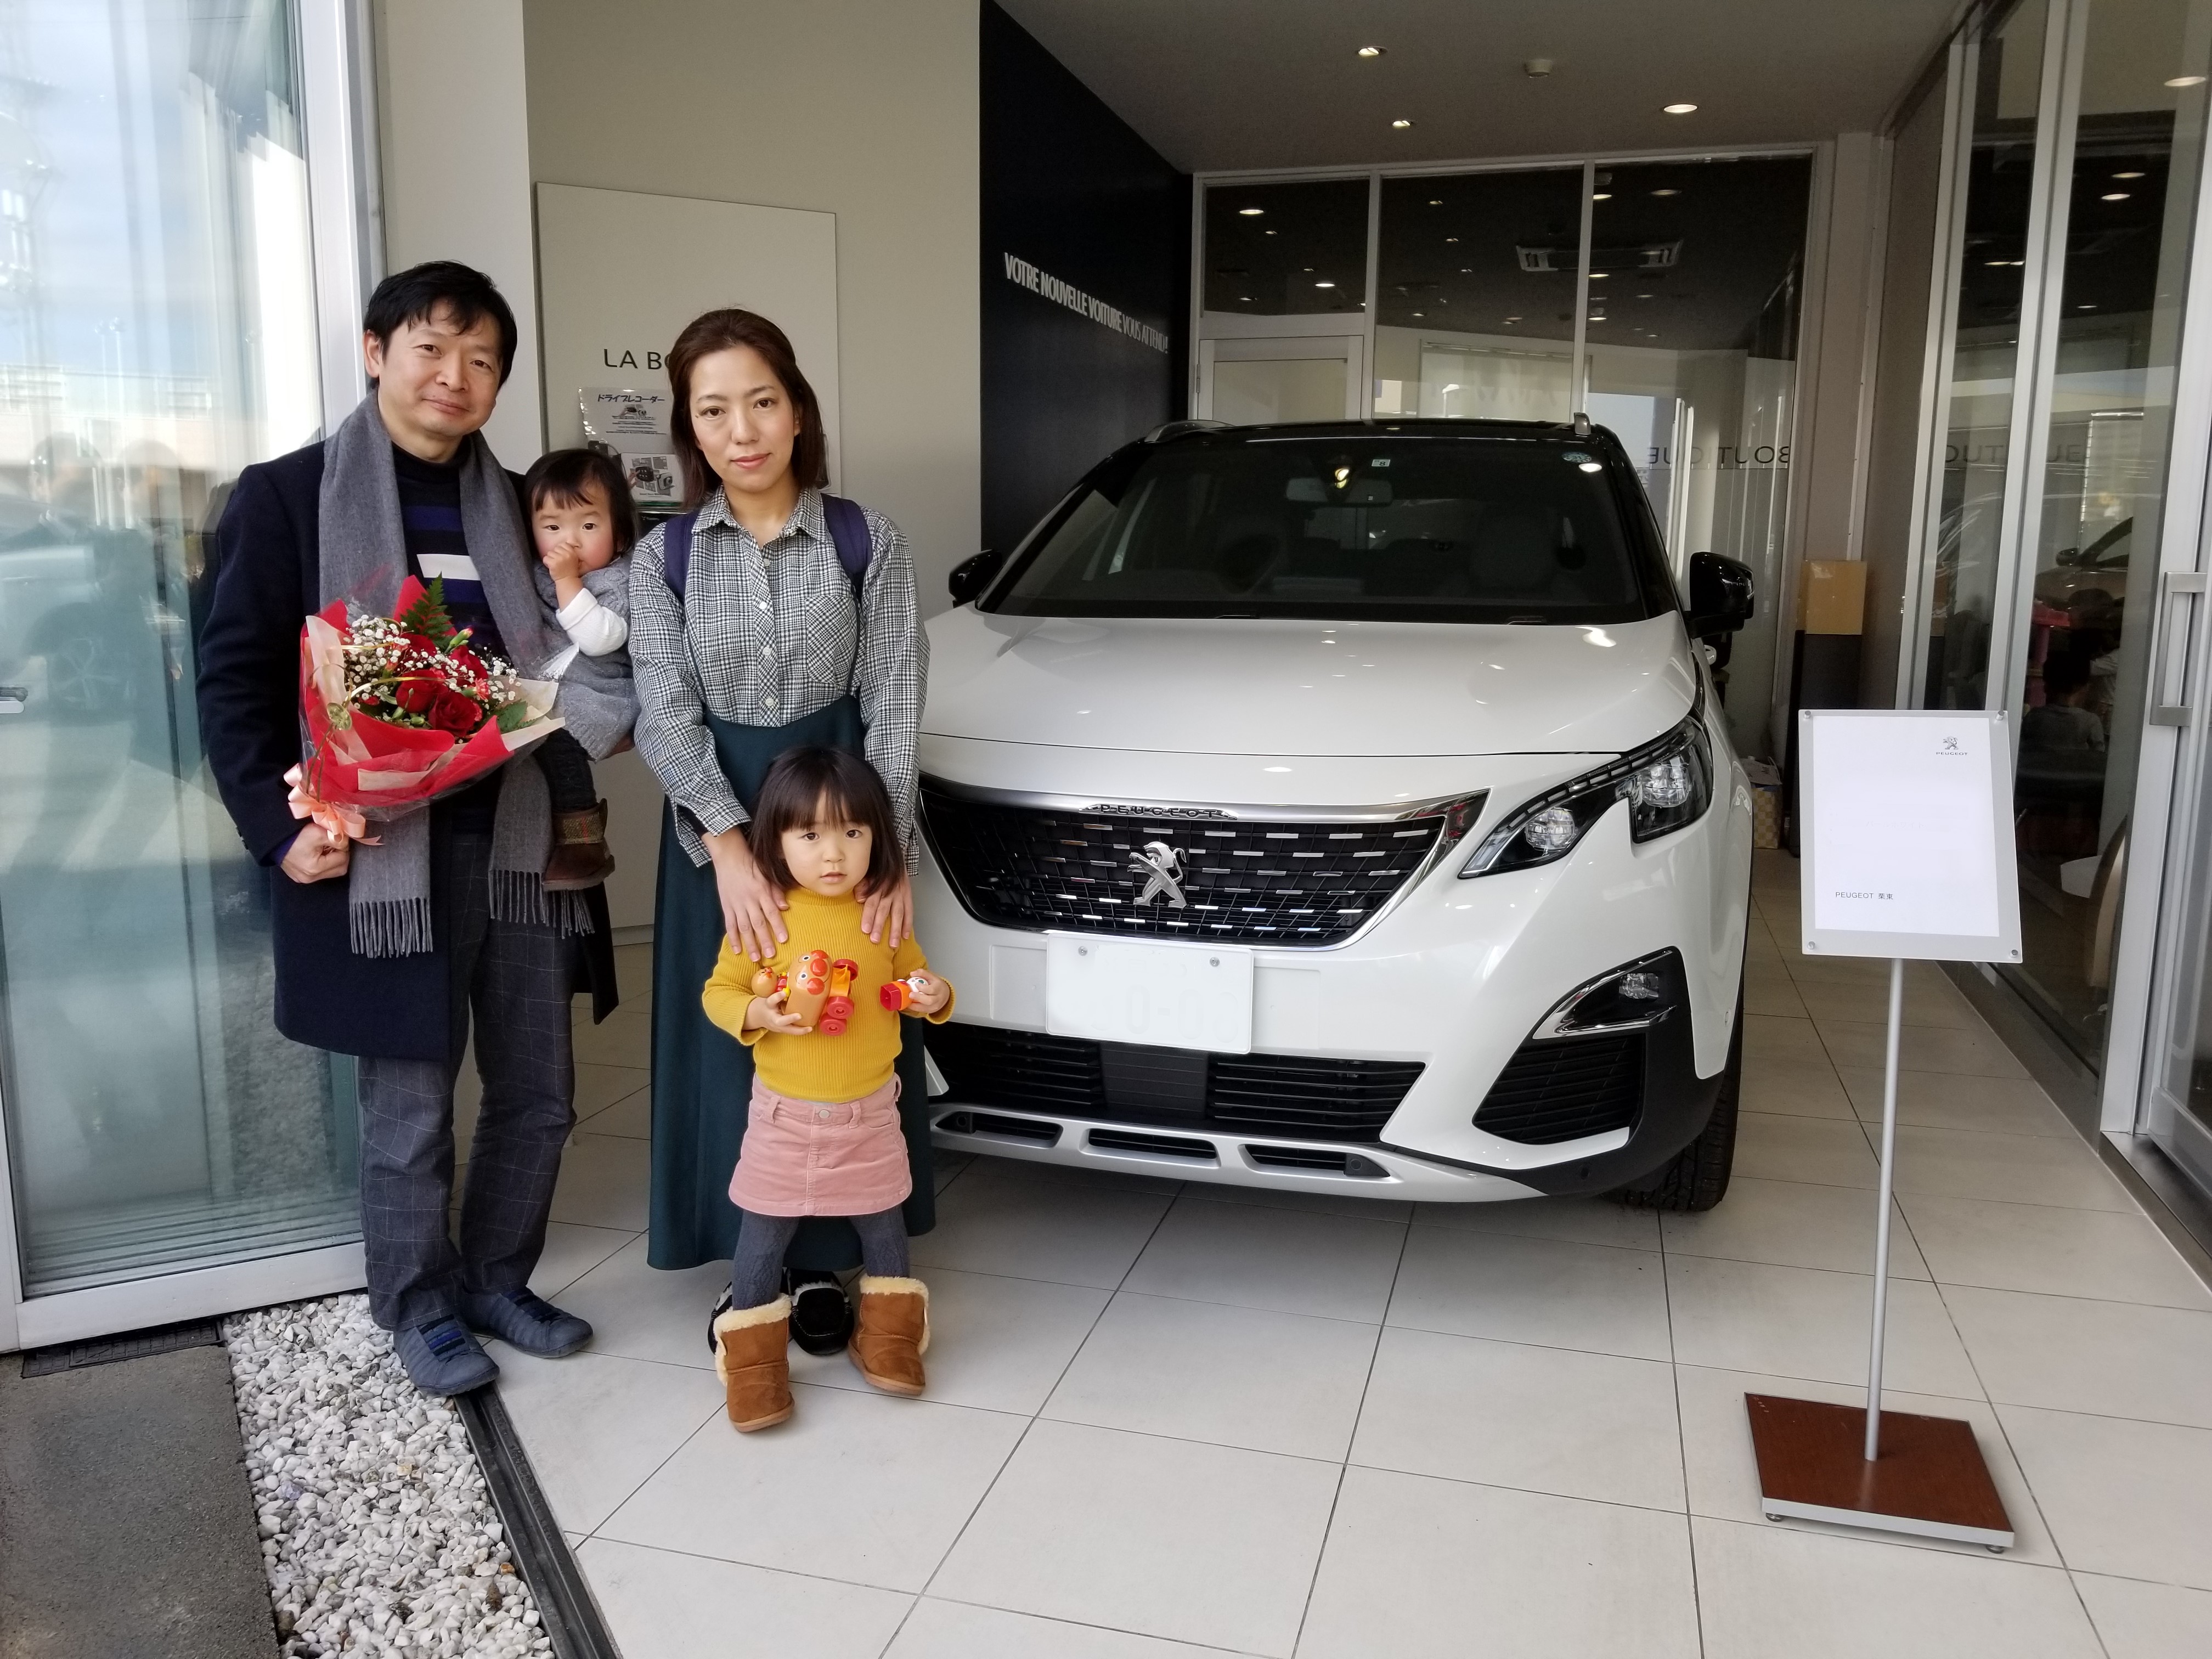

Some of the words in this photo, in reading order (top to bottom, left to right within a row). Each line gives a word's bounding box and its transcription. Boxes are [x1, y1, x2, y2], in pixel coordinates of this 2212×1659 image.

[1005, 252, 1039, 293] VOTRE
[1041, 271, 1087, 316] NOUVELLE
[1088, 296, 1122, 332] VOITURE
[1122, 314, 1141, 341] VOUS
[603, 348, 638, 369] LA
[647, 351, 670, 370] B
[1100, 804, 1218, 819] PEUGEOT
